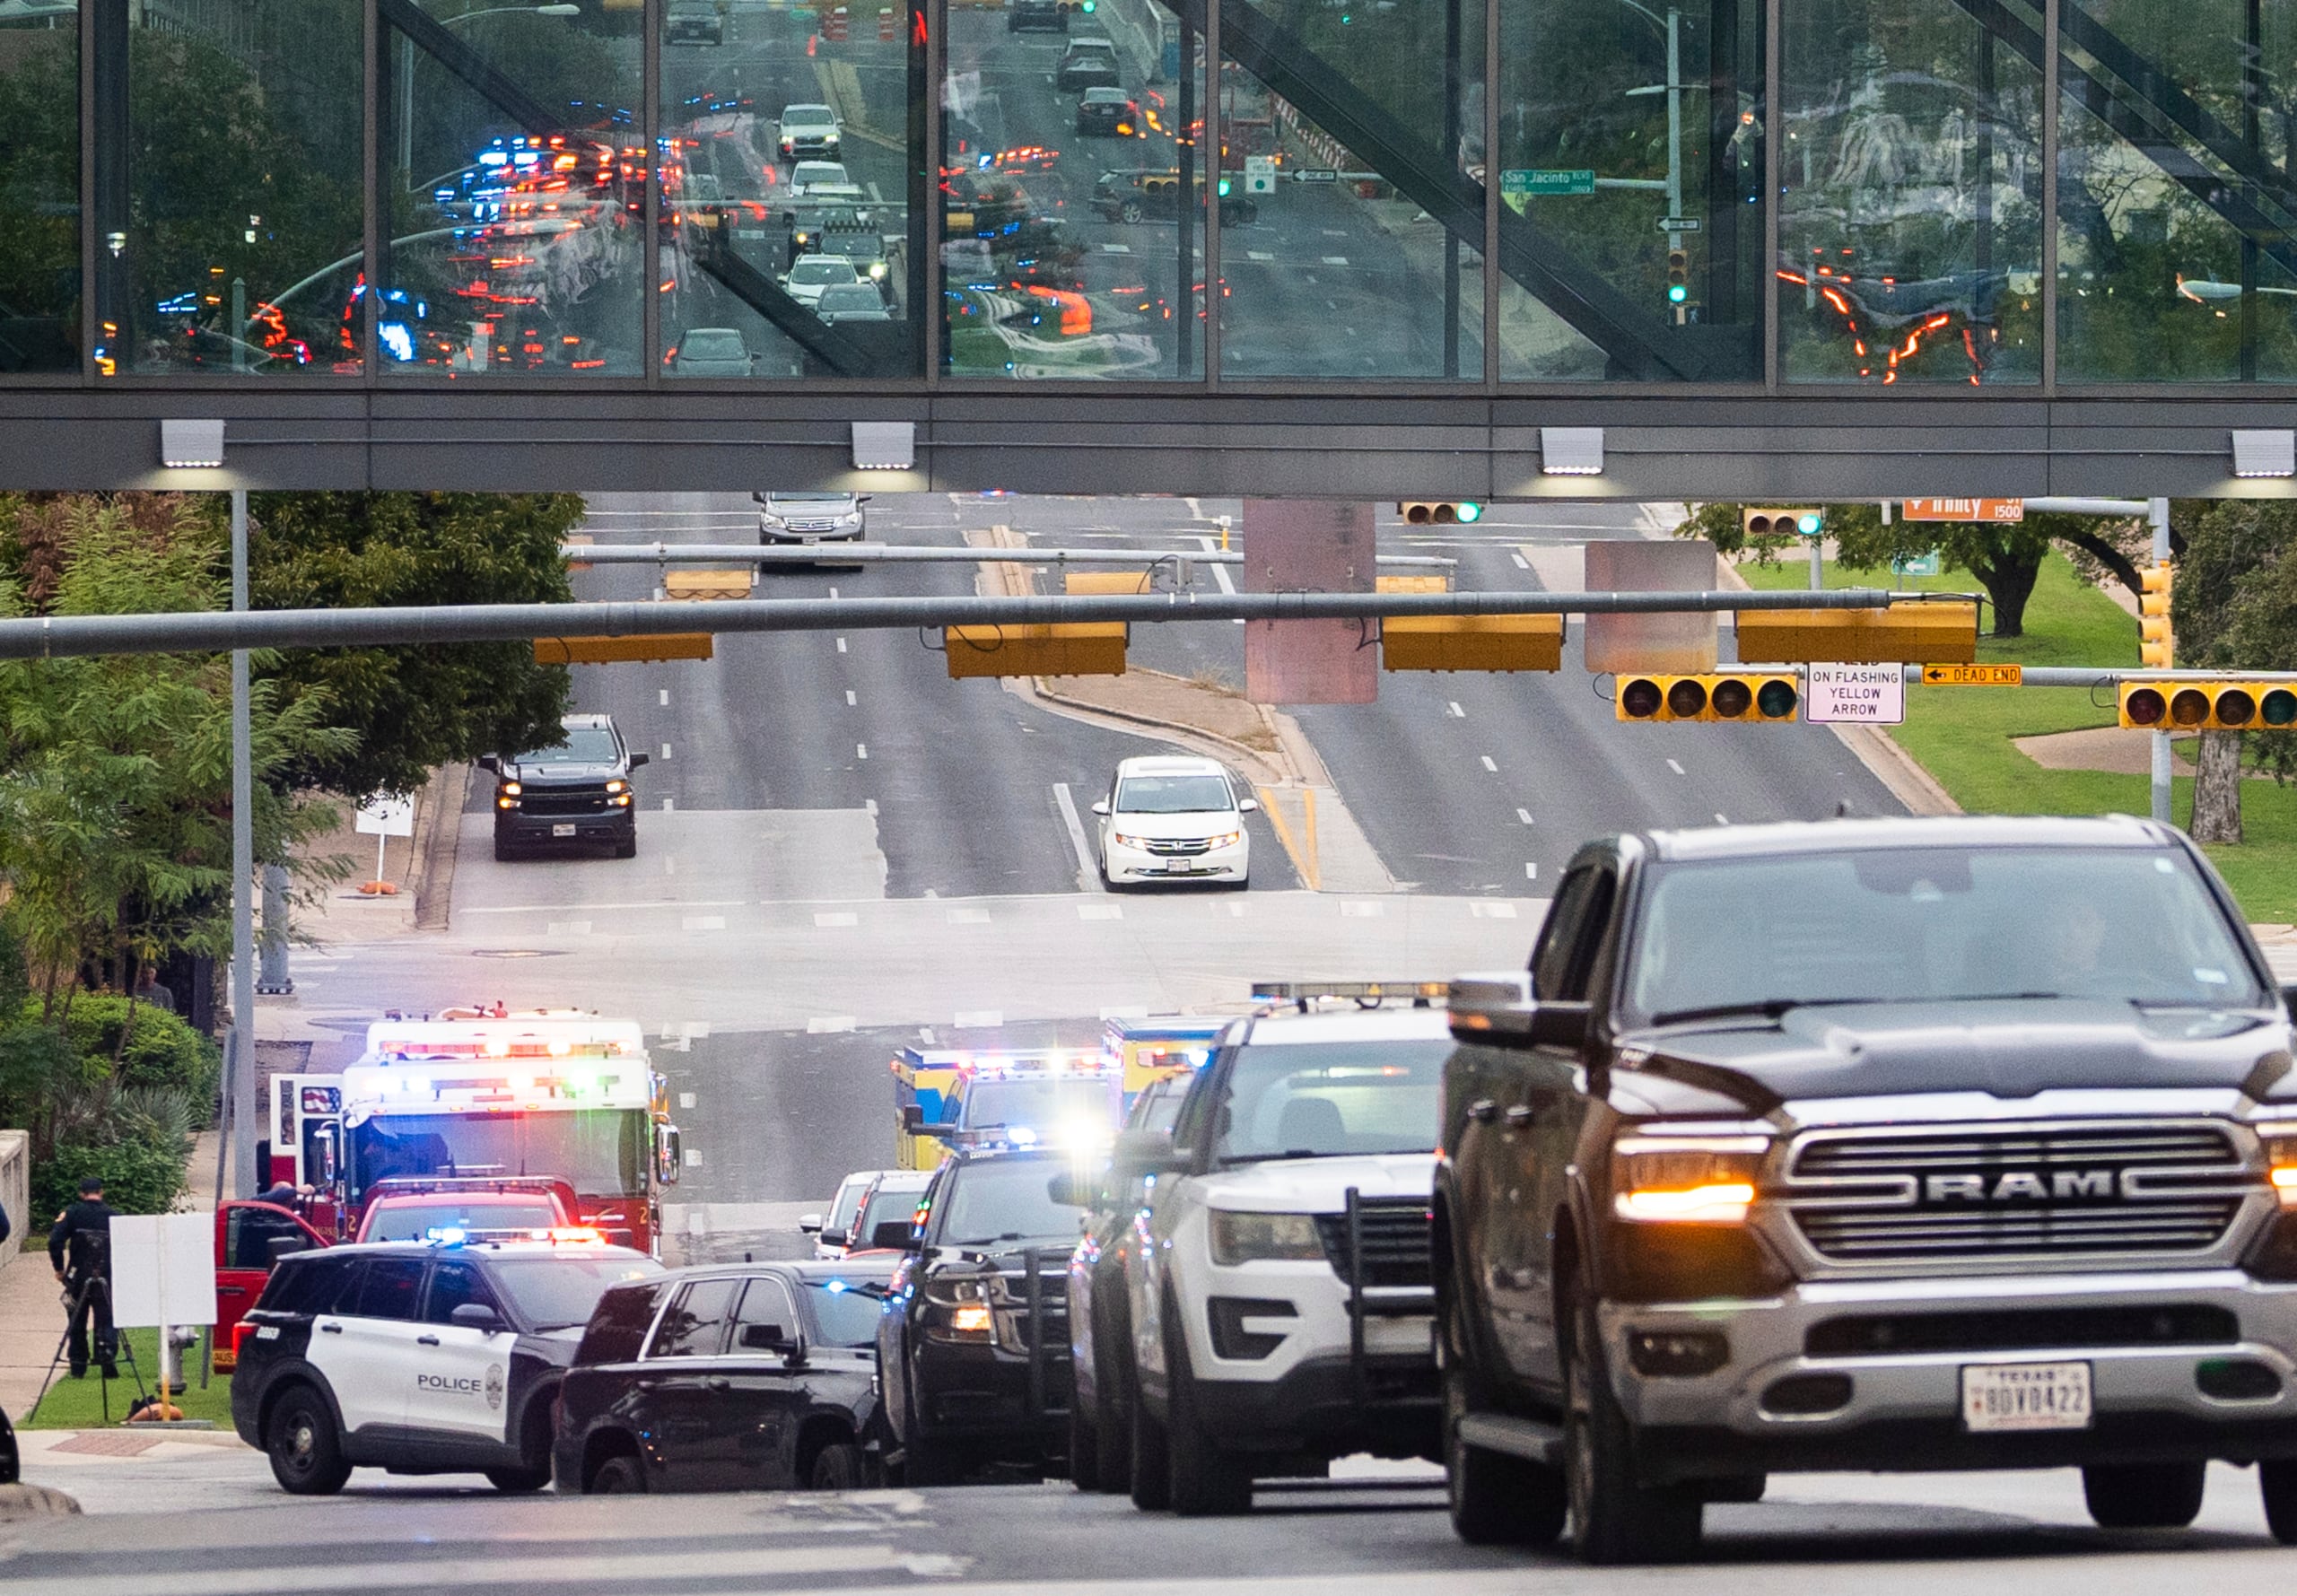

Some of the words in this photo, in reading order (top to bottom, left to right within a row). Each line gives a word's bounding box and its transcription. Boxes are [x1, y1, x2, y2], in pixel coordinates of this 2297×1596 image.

[1505, 172, 1525, 183] San
[1530, 172, 1569, 184] Jacinto
[1995, 505, 2021, 518] 1500
[1813, 672, 1830, 683] ON
[1835, 672, 1899, 684] FLASHING
[1953, 670, 1987, 682] DEAD
[1994, 670, 2017, 681] END
[1830, 688, 1881, 699] YELLOW
[1831, 704, 1877, 715] ARROW
[1926, 1170, 2113, 1201] RAM
[640, 1206, 647, 1225] 2
[348, 1215, 356, 1233] 2
[214, 1350, 234, 1363] AUS
[417, 1374, 482, 1391] POLICE
